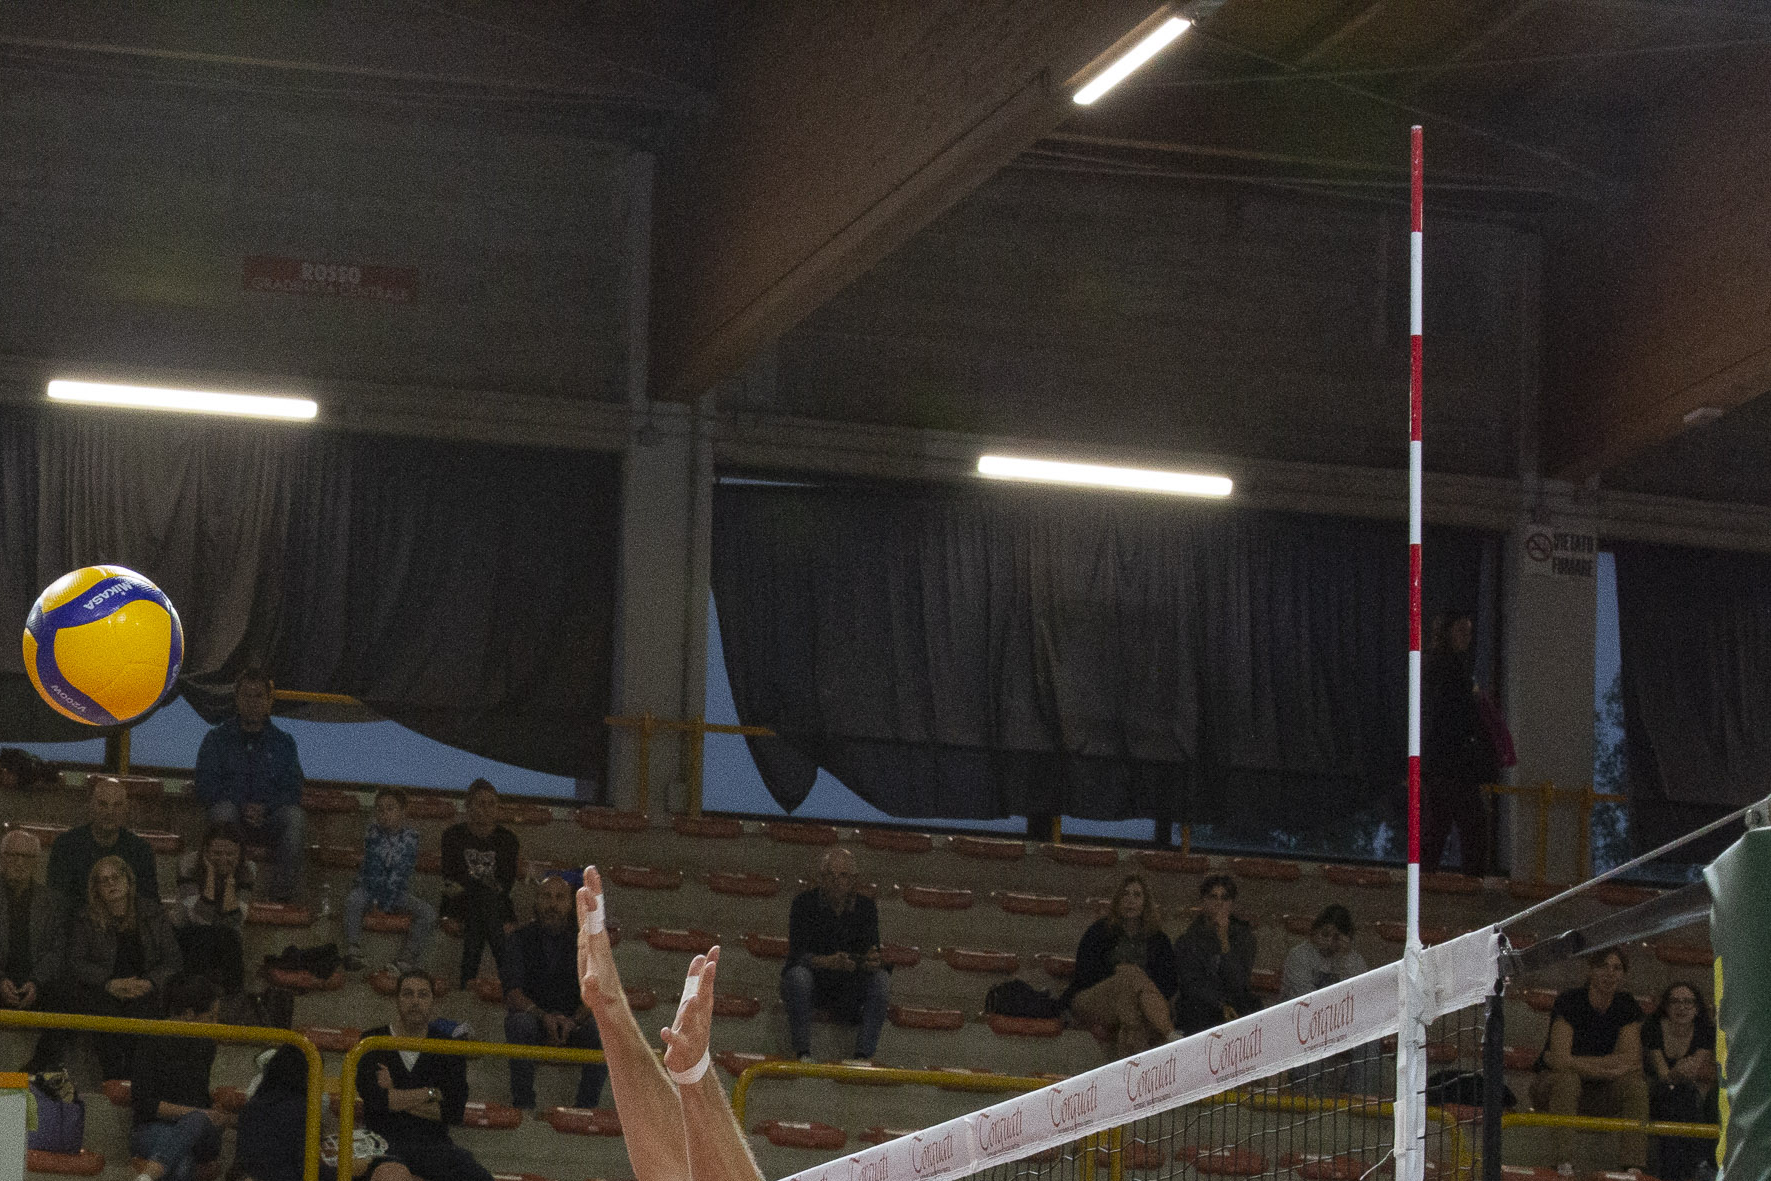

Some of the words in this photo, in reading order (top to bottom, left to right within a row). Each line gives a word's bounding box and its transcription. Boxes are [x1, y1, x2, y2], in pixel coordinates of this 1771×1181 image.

[302, 262, 362, 284] ROSSO
[84, 581, 134, 610] MIKASA
[1292, 988, 1355, 1048] Torquati
[1205, 1019, 1263, 1078] Torquati
[1124, 1049, 1178, 1104] Torquati
[978, 1101, 1024, 1152] Torquati
[1047, 1077, 1099, 1129] Torquati
[909, 1127, 954, 1175] Torquati
